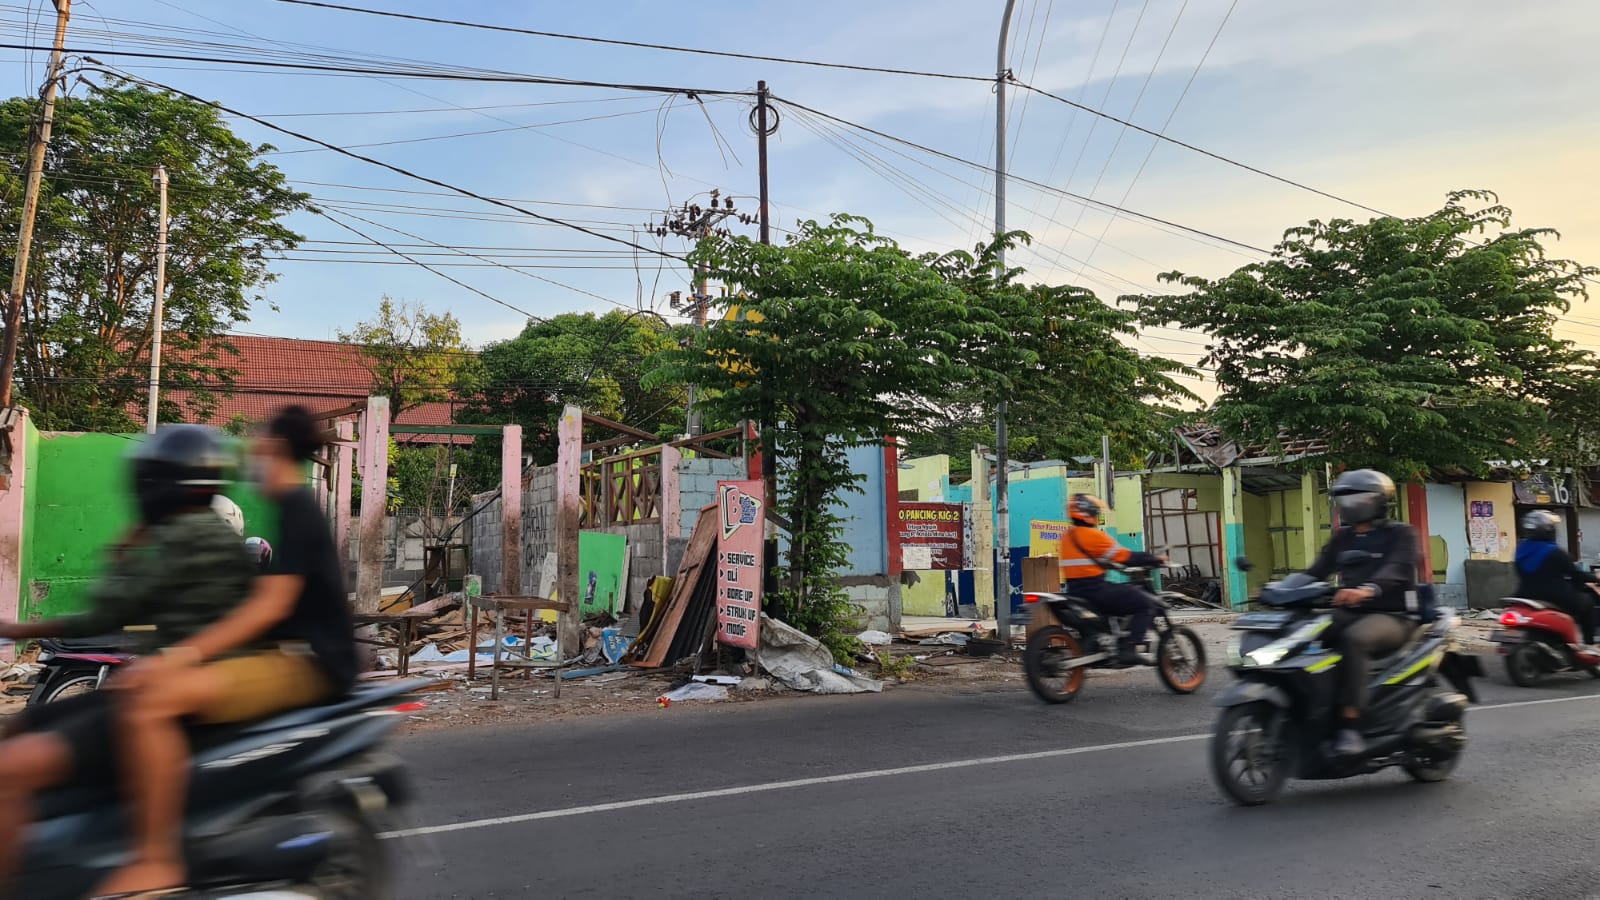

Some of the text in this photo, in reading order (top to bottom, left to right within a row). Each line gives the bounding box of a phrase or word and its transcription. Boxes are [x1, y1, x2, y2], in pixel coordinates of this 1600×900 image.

[906, 509, 937, 520] PANCING
[953, 511, 959, 521] 2
[727, 551, 755, 567] SERVICE
[727, 588, 754, 602] BORE UP
